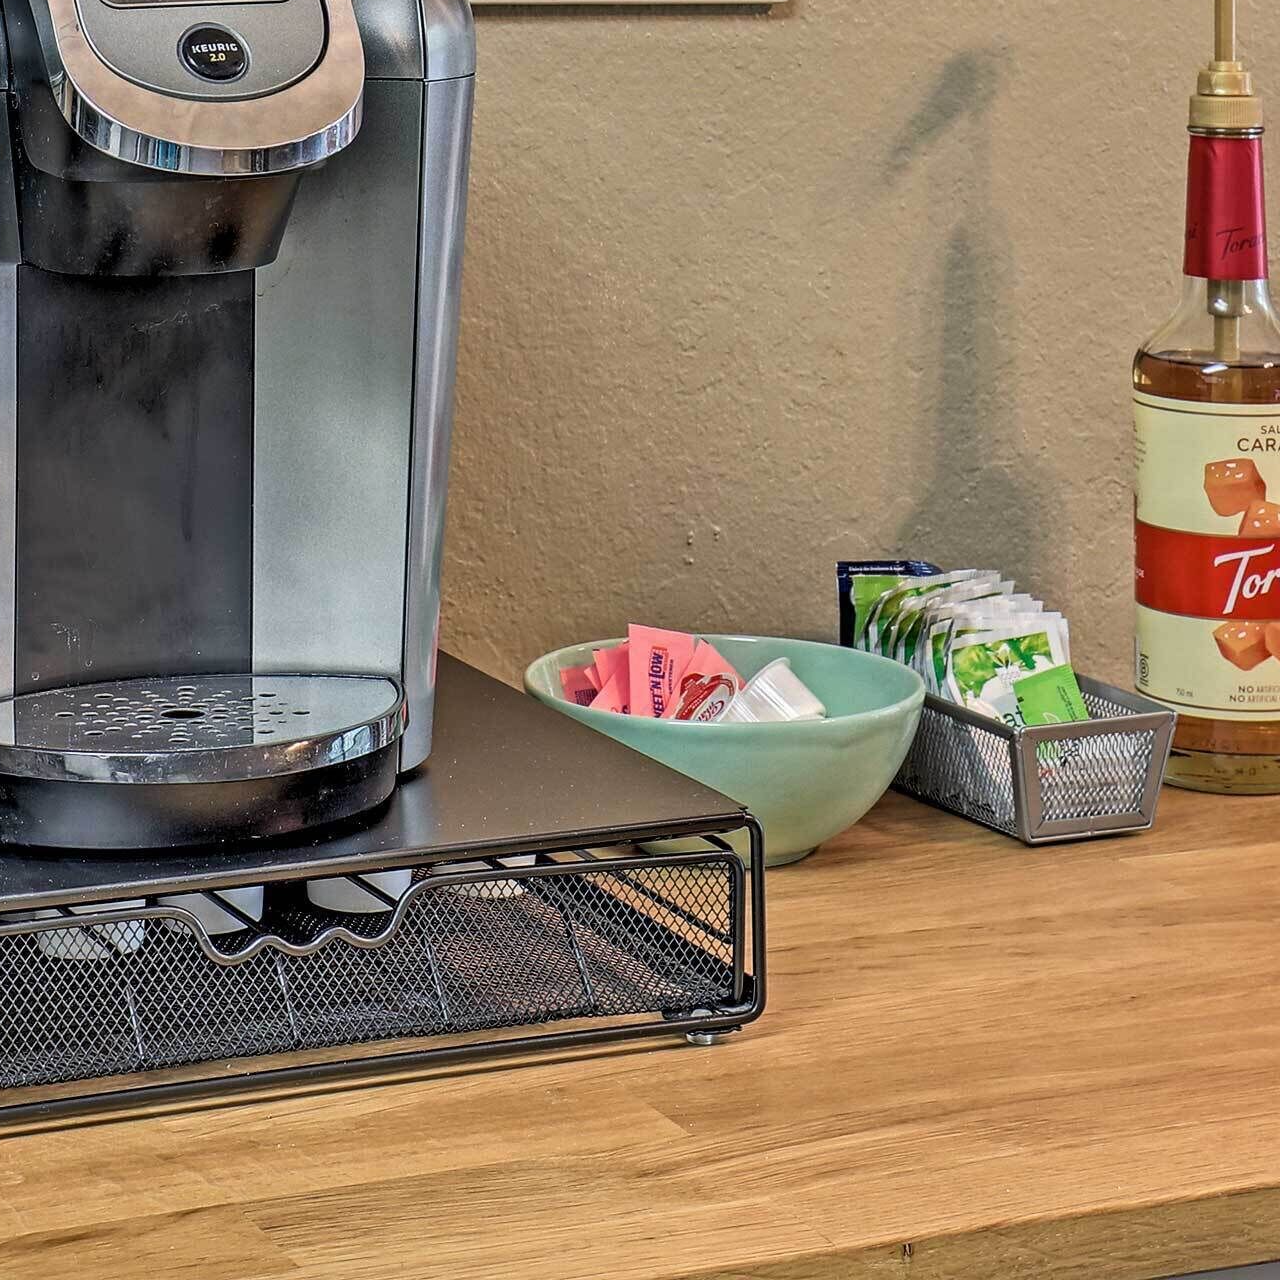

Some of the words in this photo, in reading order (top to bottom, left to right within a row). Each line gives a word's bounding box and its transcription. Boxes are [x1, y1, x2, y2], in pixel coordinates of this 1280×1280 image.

[191, 43, 238, 53] KEURIG
[209, 53, 226, 62] 2.0
[1238, 685, 1254, 694] NO
[1229, 694, 1246, 703] NO
